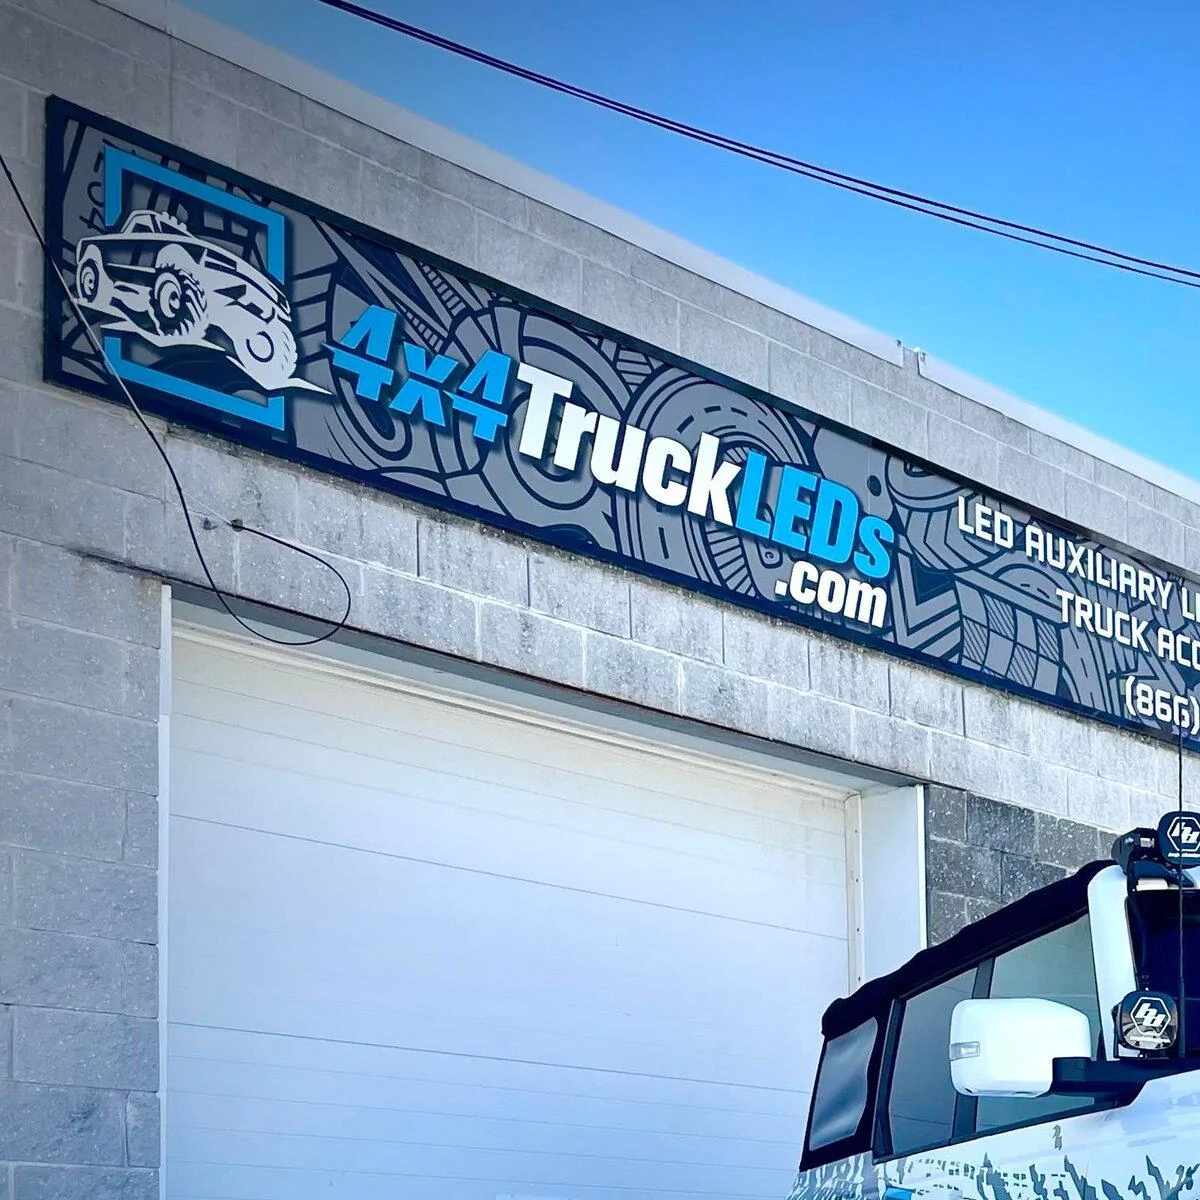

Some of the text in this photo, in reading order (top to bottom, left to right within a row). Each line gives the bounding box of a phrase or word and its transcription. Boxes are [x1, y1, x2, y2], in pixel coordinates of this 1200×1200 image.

[958, 495, 1014, 550] LED
[1025, 523, 1172, 610] AUXILIARY
[774, 560, 888, 628] .com
[1055, 588, 1149, 653] TRUCK
[1125, 675, 1200, 735] (866)
